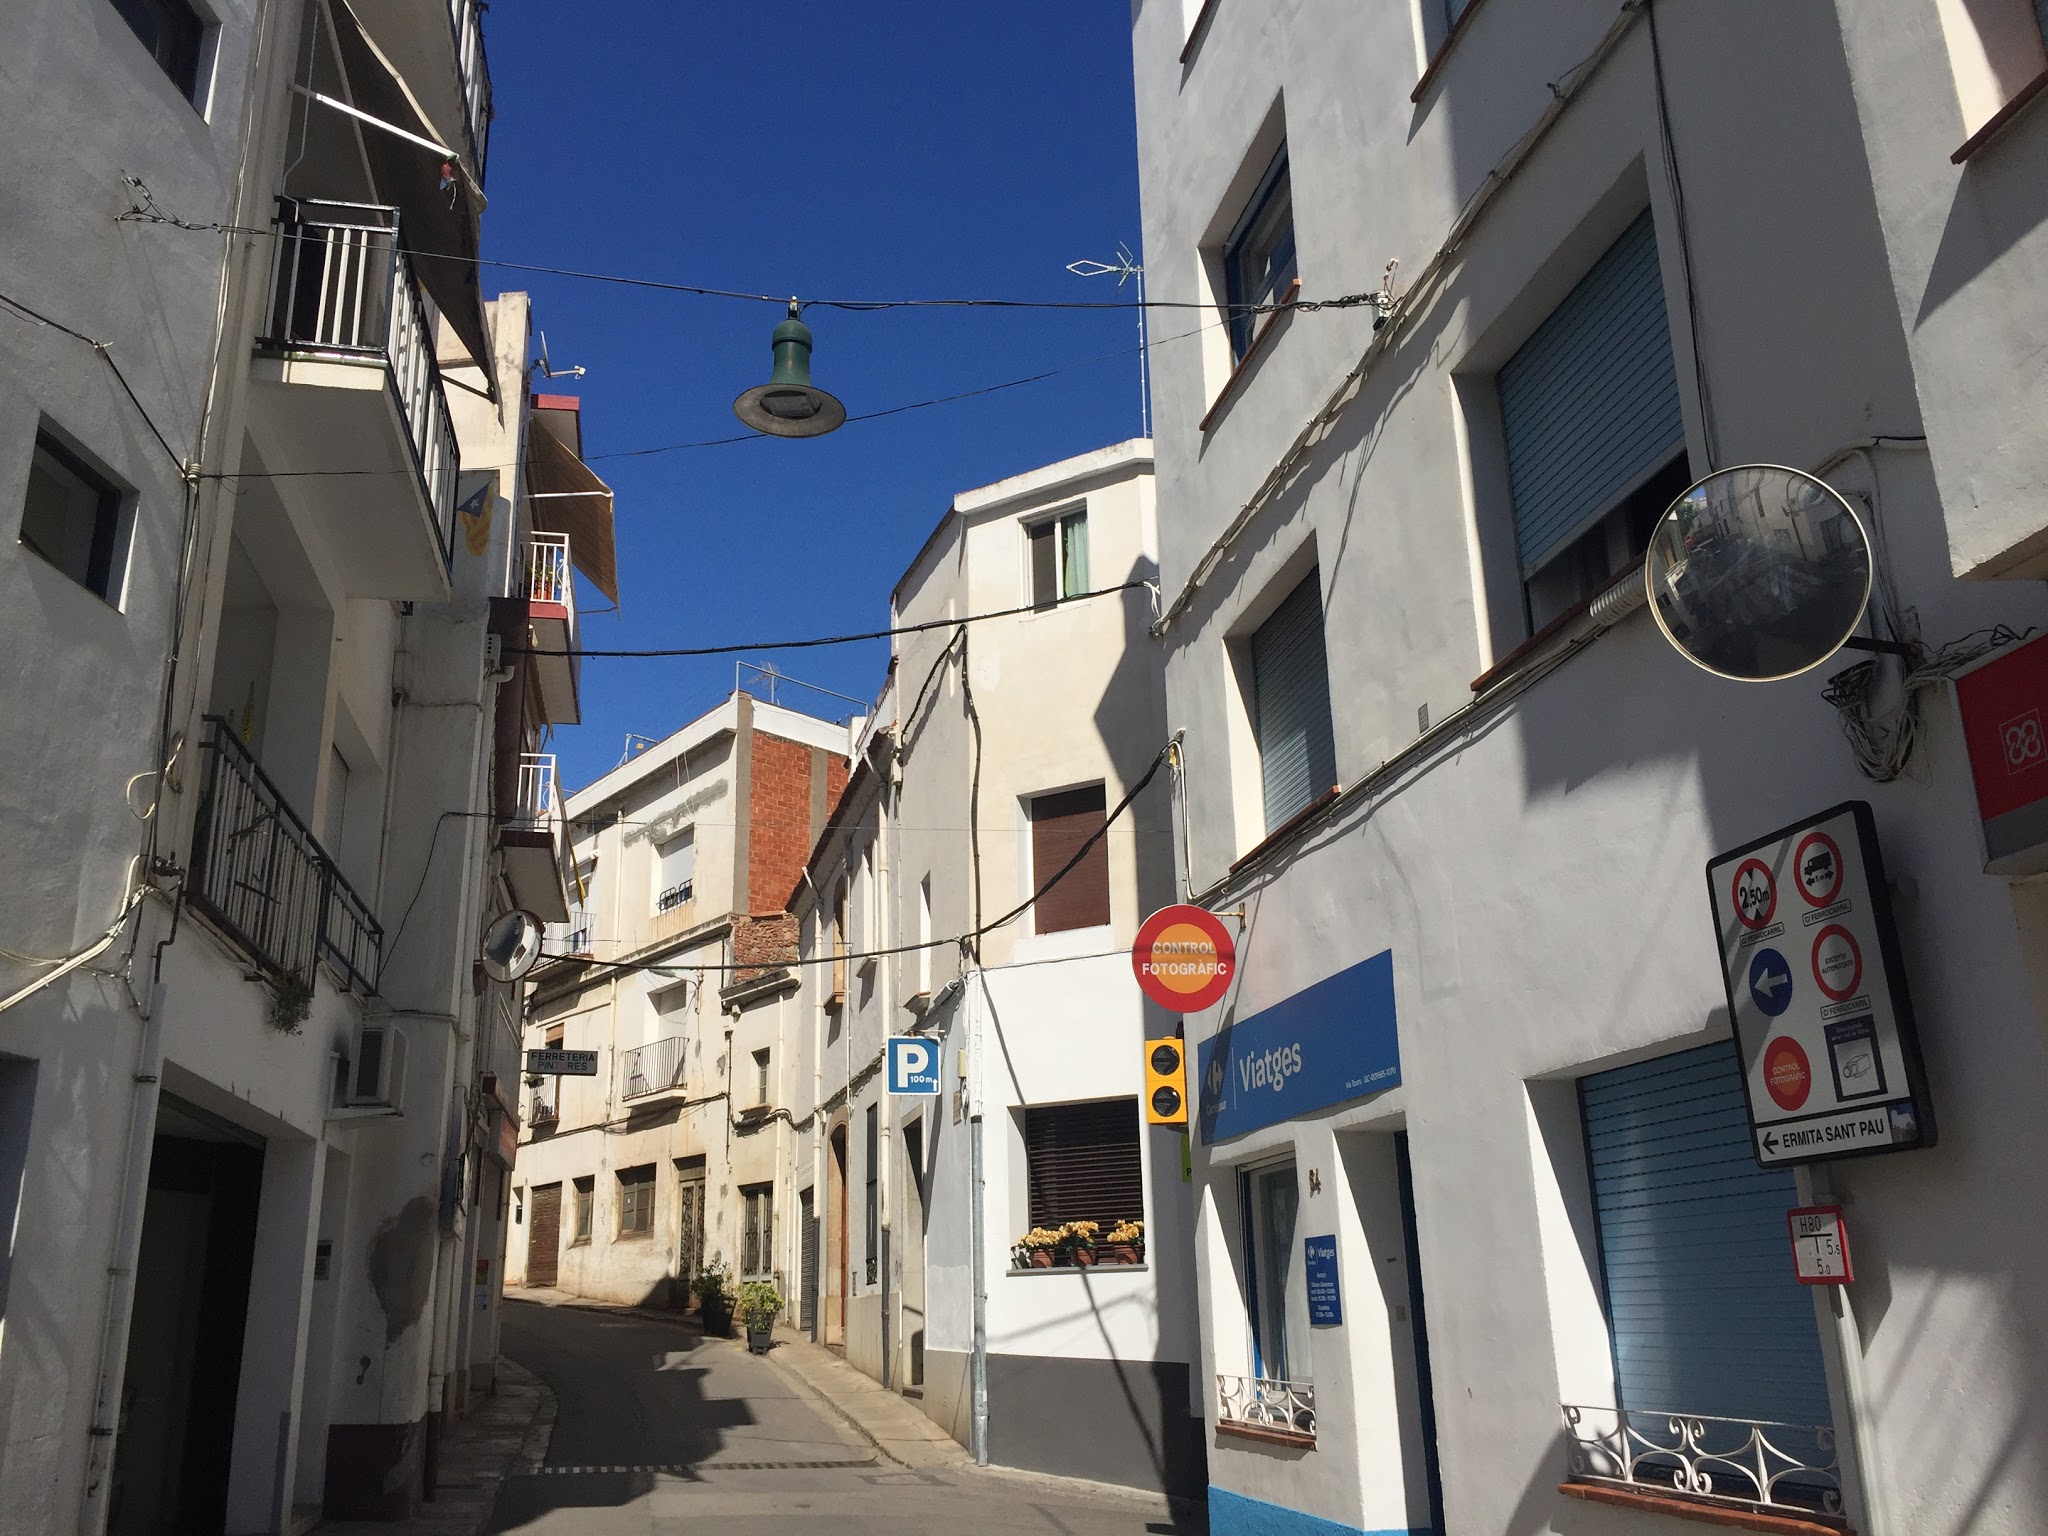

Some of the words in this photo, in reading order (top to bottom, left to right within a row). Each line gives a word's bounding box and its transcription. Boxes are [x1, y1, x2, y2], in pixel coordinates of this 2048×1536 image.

[1811, 903, 1849, 921] FERROCARRIL
[1748, 925, 1783, 943] FERROCARRIL
[1152, 941, 1217, 955] CONTROL
[1142, 959, 1227, 976] FOTOGRÀFIC
[1829, 999, 1868, 1015] FERROCARRIL
[531, 1051, 596, 1062] FERRETERIA
[537, 1061, 588, 1071] PINTURES
[897, 1043, 929, 1088] P
[1238, 1042, 1302, 1092] Viatges
[1772, 1062, 1801, 1075] CONTROL
[910, 1075, 925, 1083] 100
[1782, 1128, 1824, 1148] ERMITA
[1825, 1122, 1857, 1142] SANT
[1859, 1118, 1885, 1137] PAU
[1799, 1215, 1822, 1233] H80
